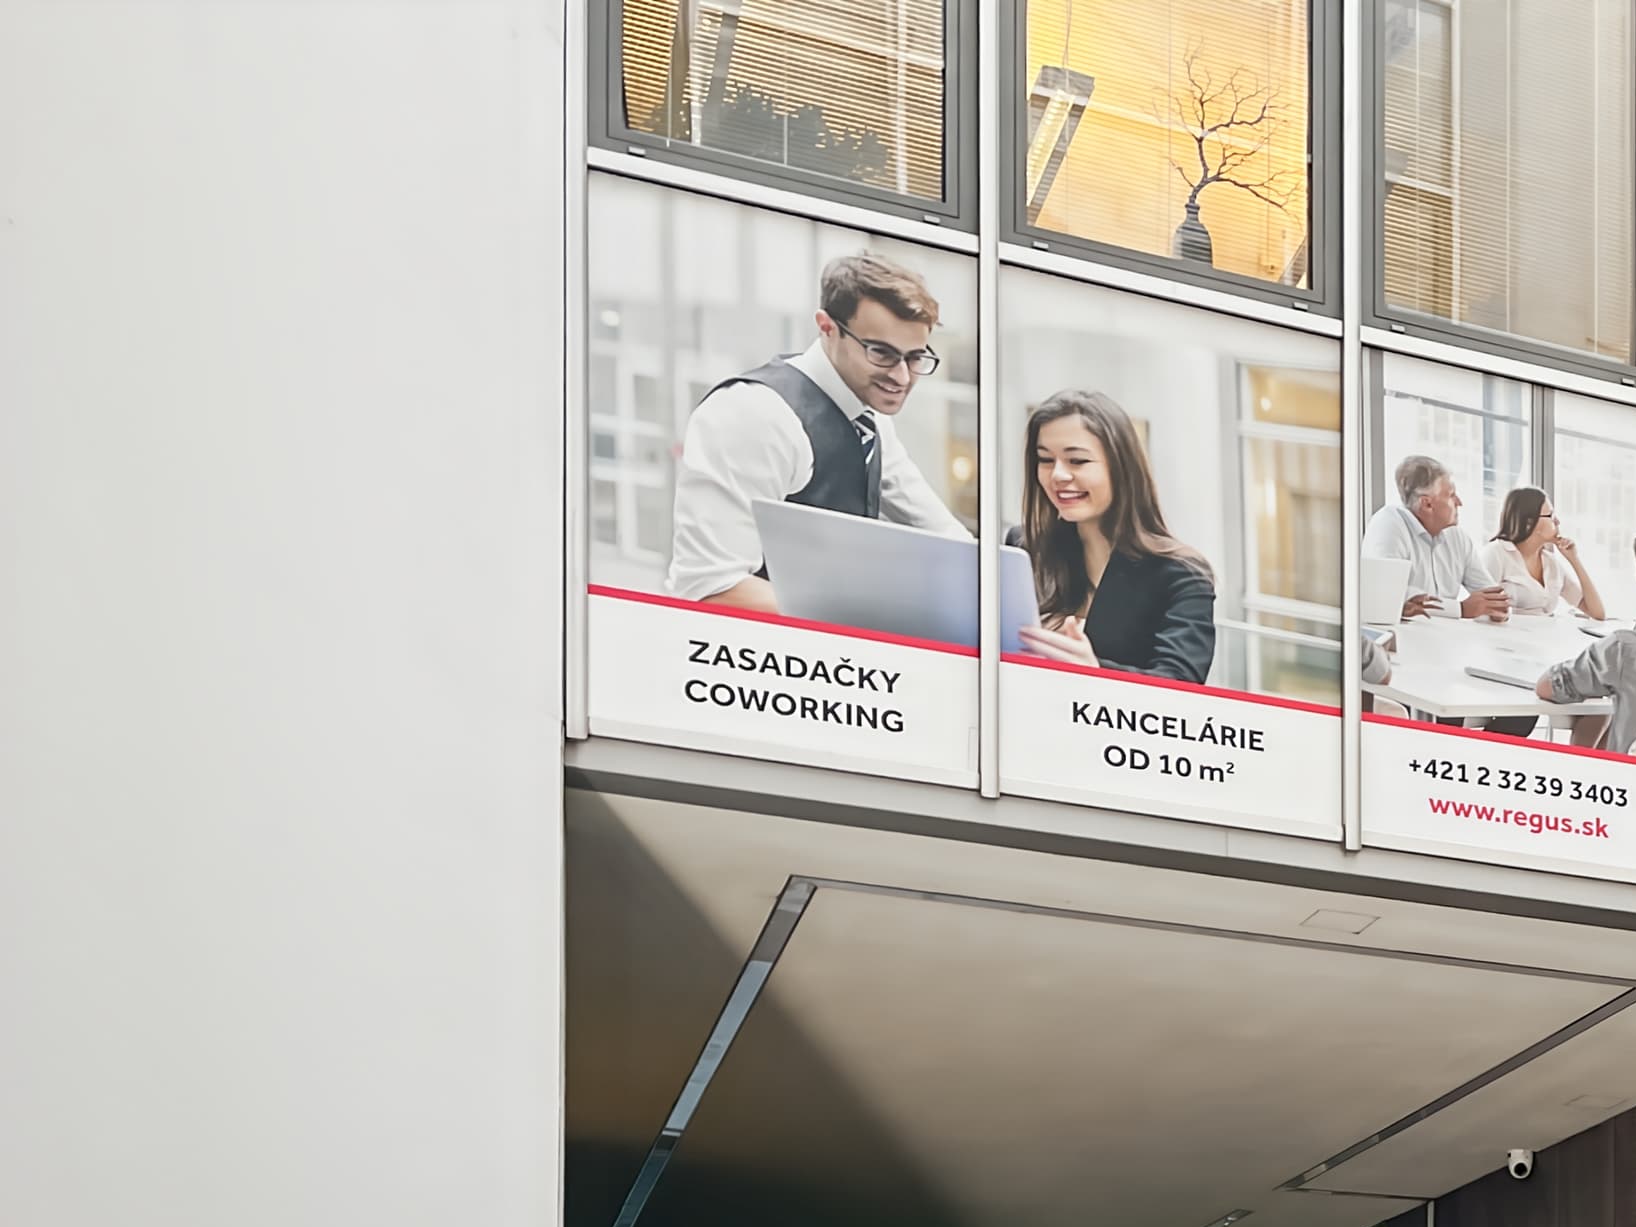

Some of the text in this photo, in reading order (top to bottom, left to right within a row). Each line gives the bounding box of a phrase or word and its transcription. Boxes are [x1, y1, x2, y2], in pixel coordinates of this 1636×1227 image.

[689, 639, 901, 694] ZASADAČKY
[684, 679, 904, 733] COWORKING
[1072, 701, 1265, 752] KANCELÁRIE
[1103, 745, 1150, 770] OD
[1159, 754, 1192, 778] 10
[1408, 759, 1628, 807] +421 2 32 39 3403
[1429, 799, 1608, 837] www.regus.sk
